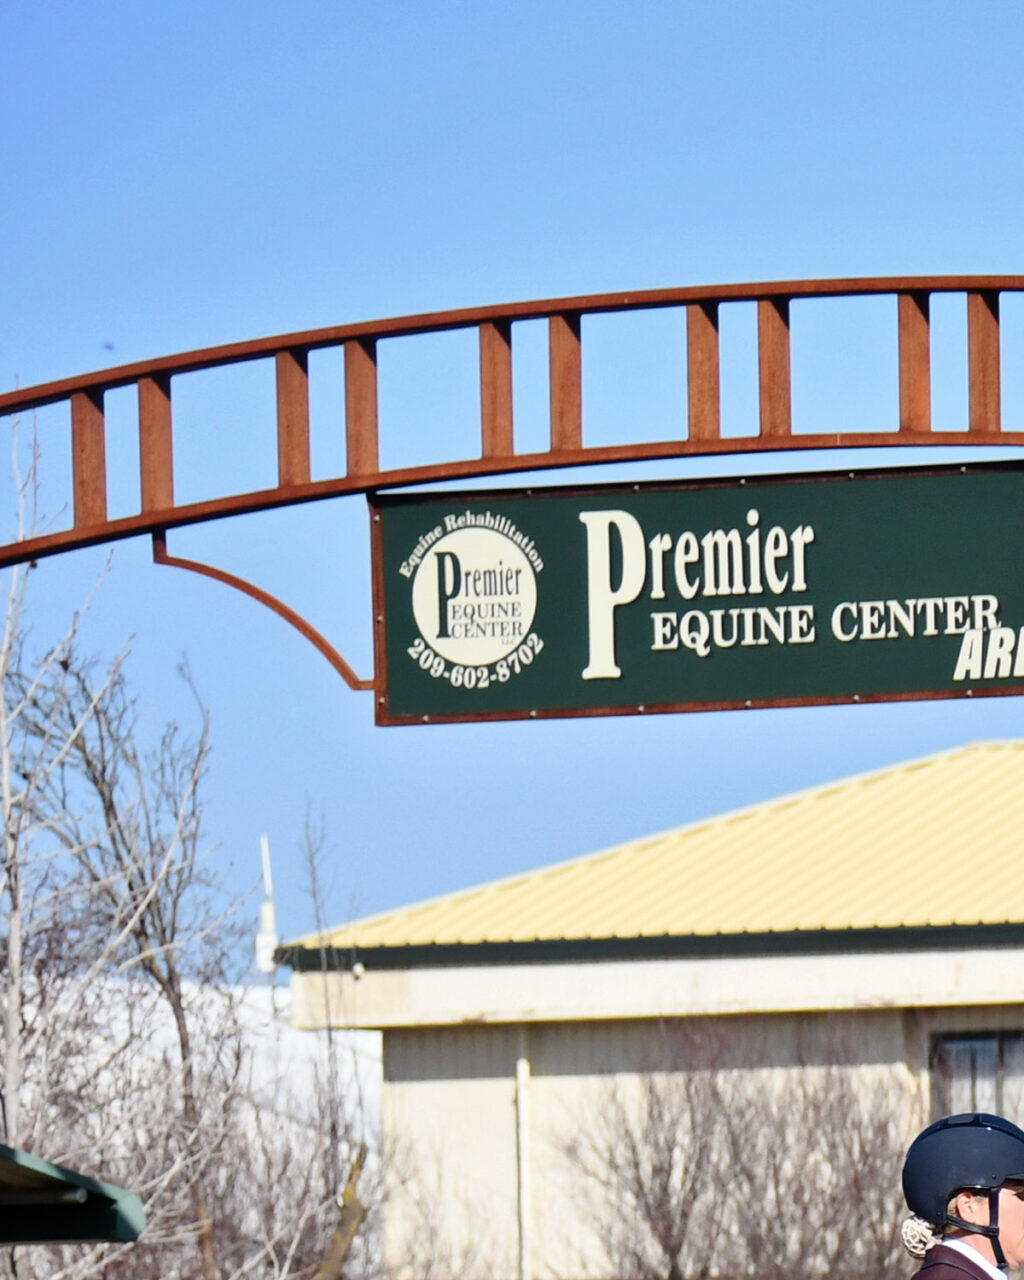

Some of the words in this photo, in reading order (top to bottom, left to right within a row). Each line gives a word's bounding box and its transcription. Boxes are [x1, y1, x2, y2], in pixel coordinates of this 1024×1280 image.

[399, 525, 443, 579] Equine
[443, 510, 544, 573] Rehabilitation
[434, 551, 522, 639] Premier
[451, 602, 522, 624] EQUINE
[579, 508, 815, 680] Premier
[451, 621, 523, 640] CENTER
[651, 606, 816, 657] EQUINE
[831, 595, 1001, 642] CENTER
[407, 632, 545, 690] 209-602-8702
